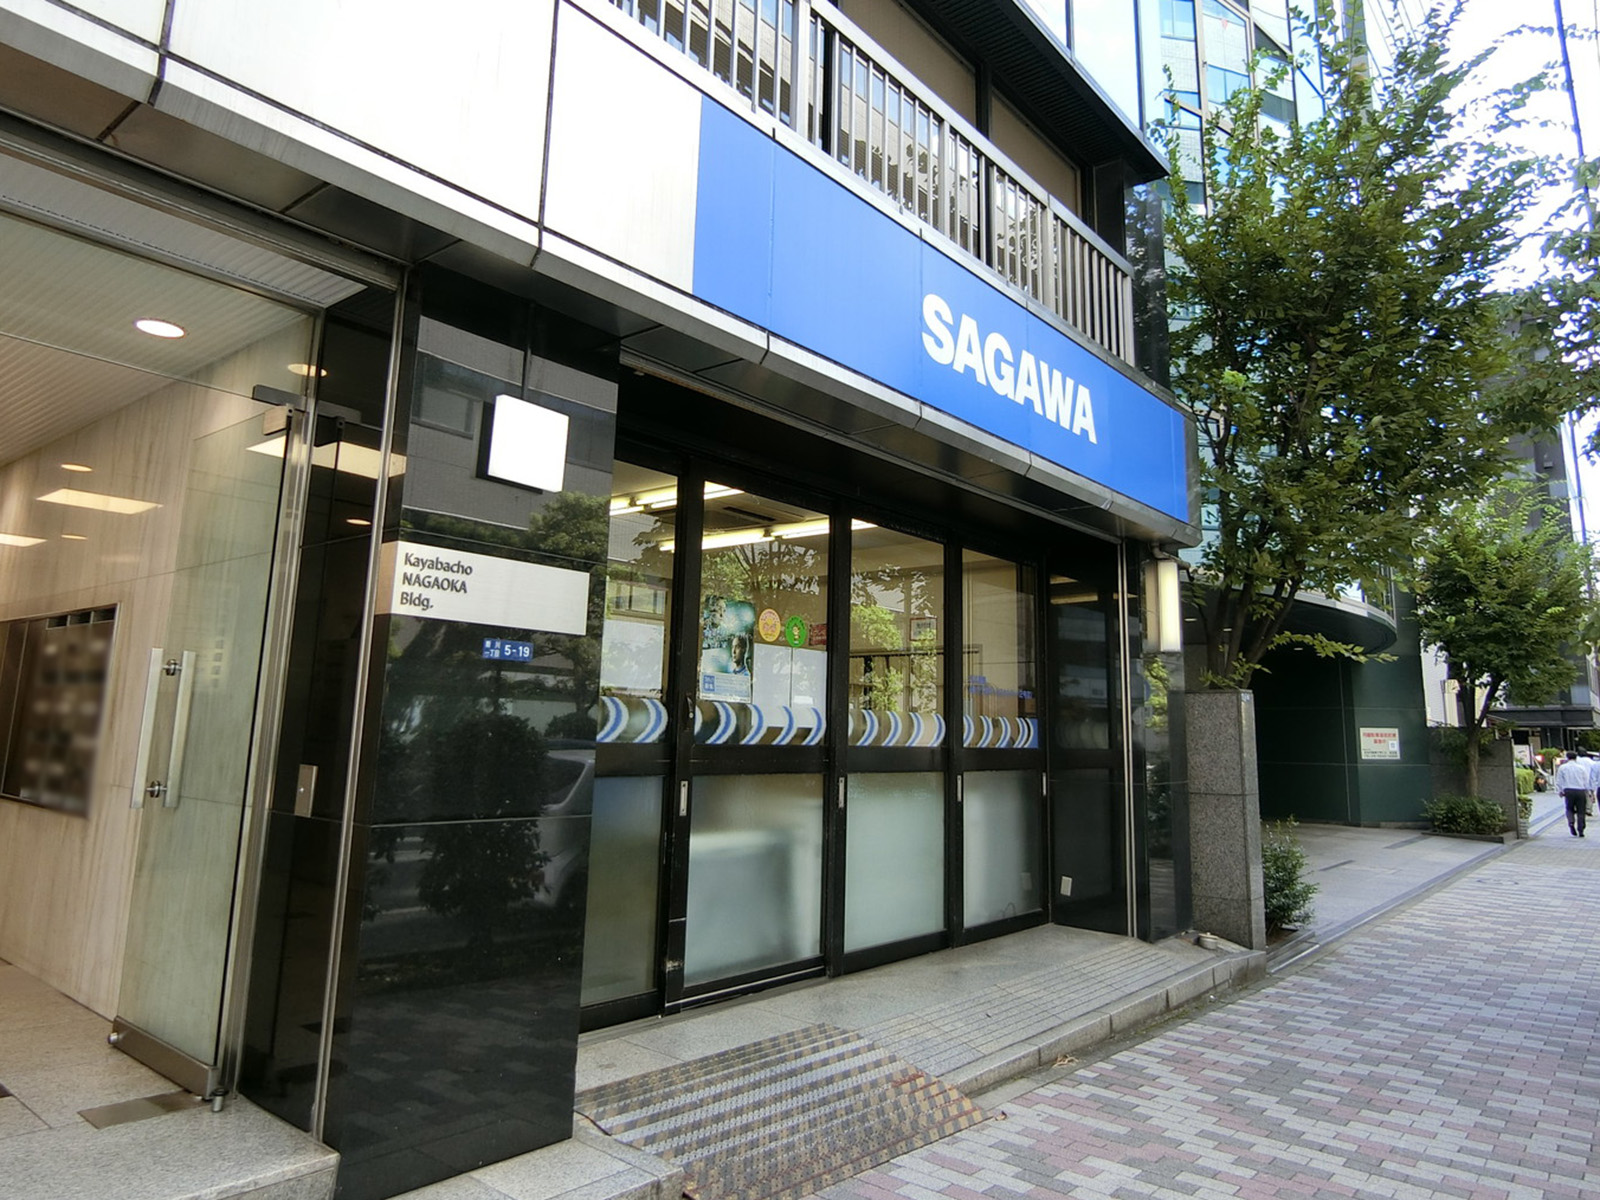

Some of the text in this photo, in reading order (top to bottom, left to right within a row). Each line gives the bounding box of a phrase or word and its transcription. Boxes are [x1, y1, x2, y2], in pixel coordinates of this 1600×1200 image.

[921, 293, 1097, 444] SAGAWA
[404, 552, 473, 576] Kayabacho
[402, 572, 468, 594] NAGAOKA
[400, 591, 434, 611] Bldg.
[504, 644, 530, 658] 5-19
